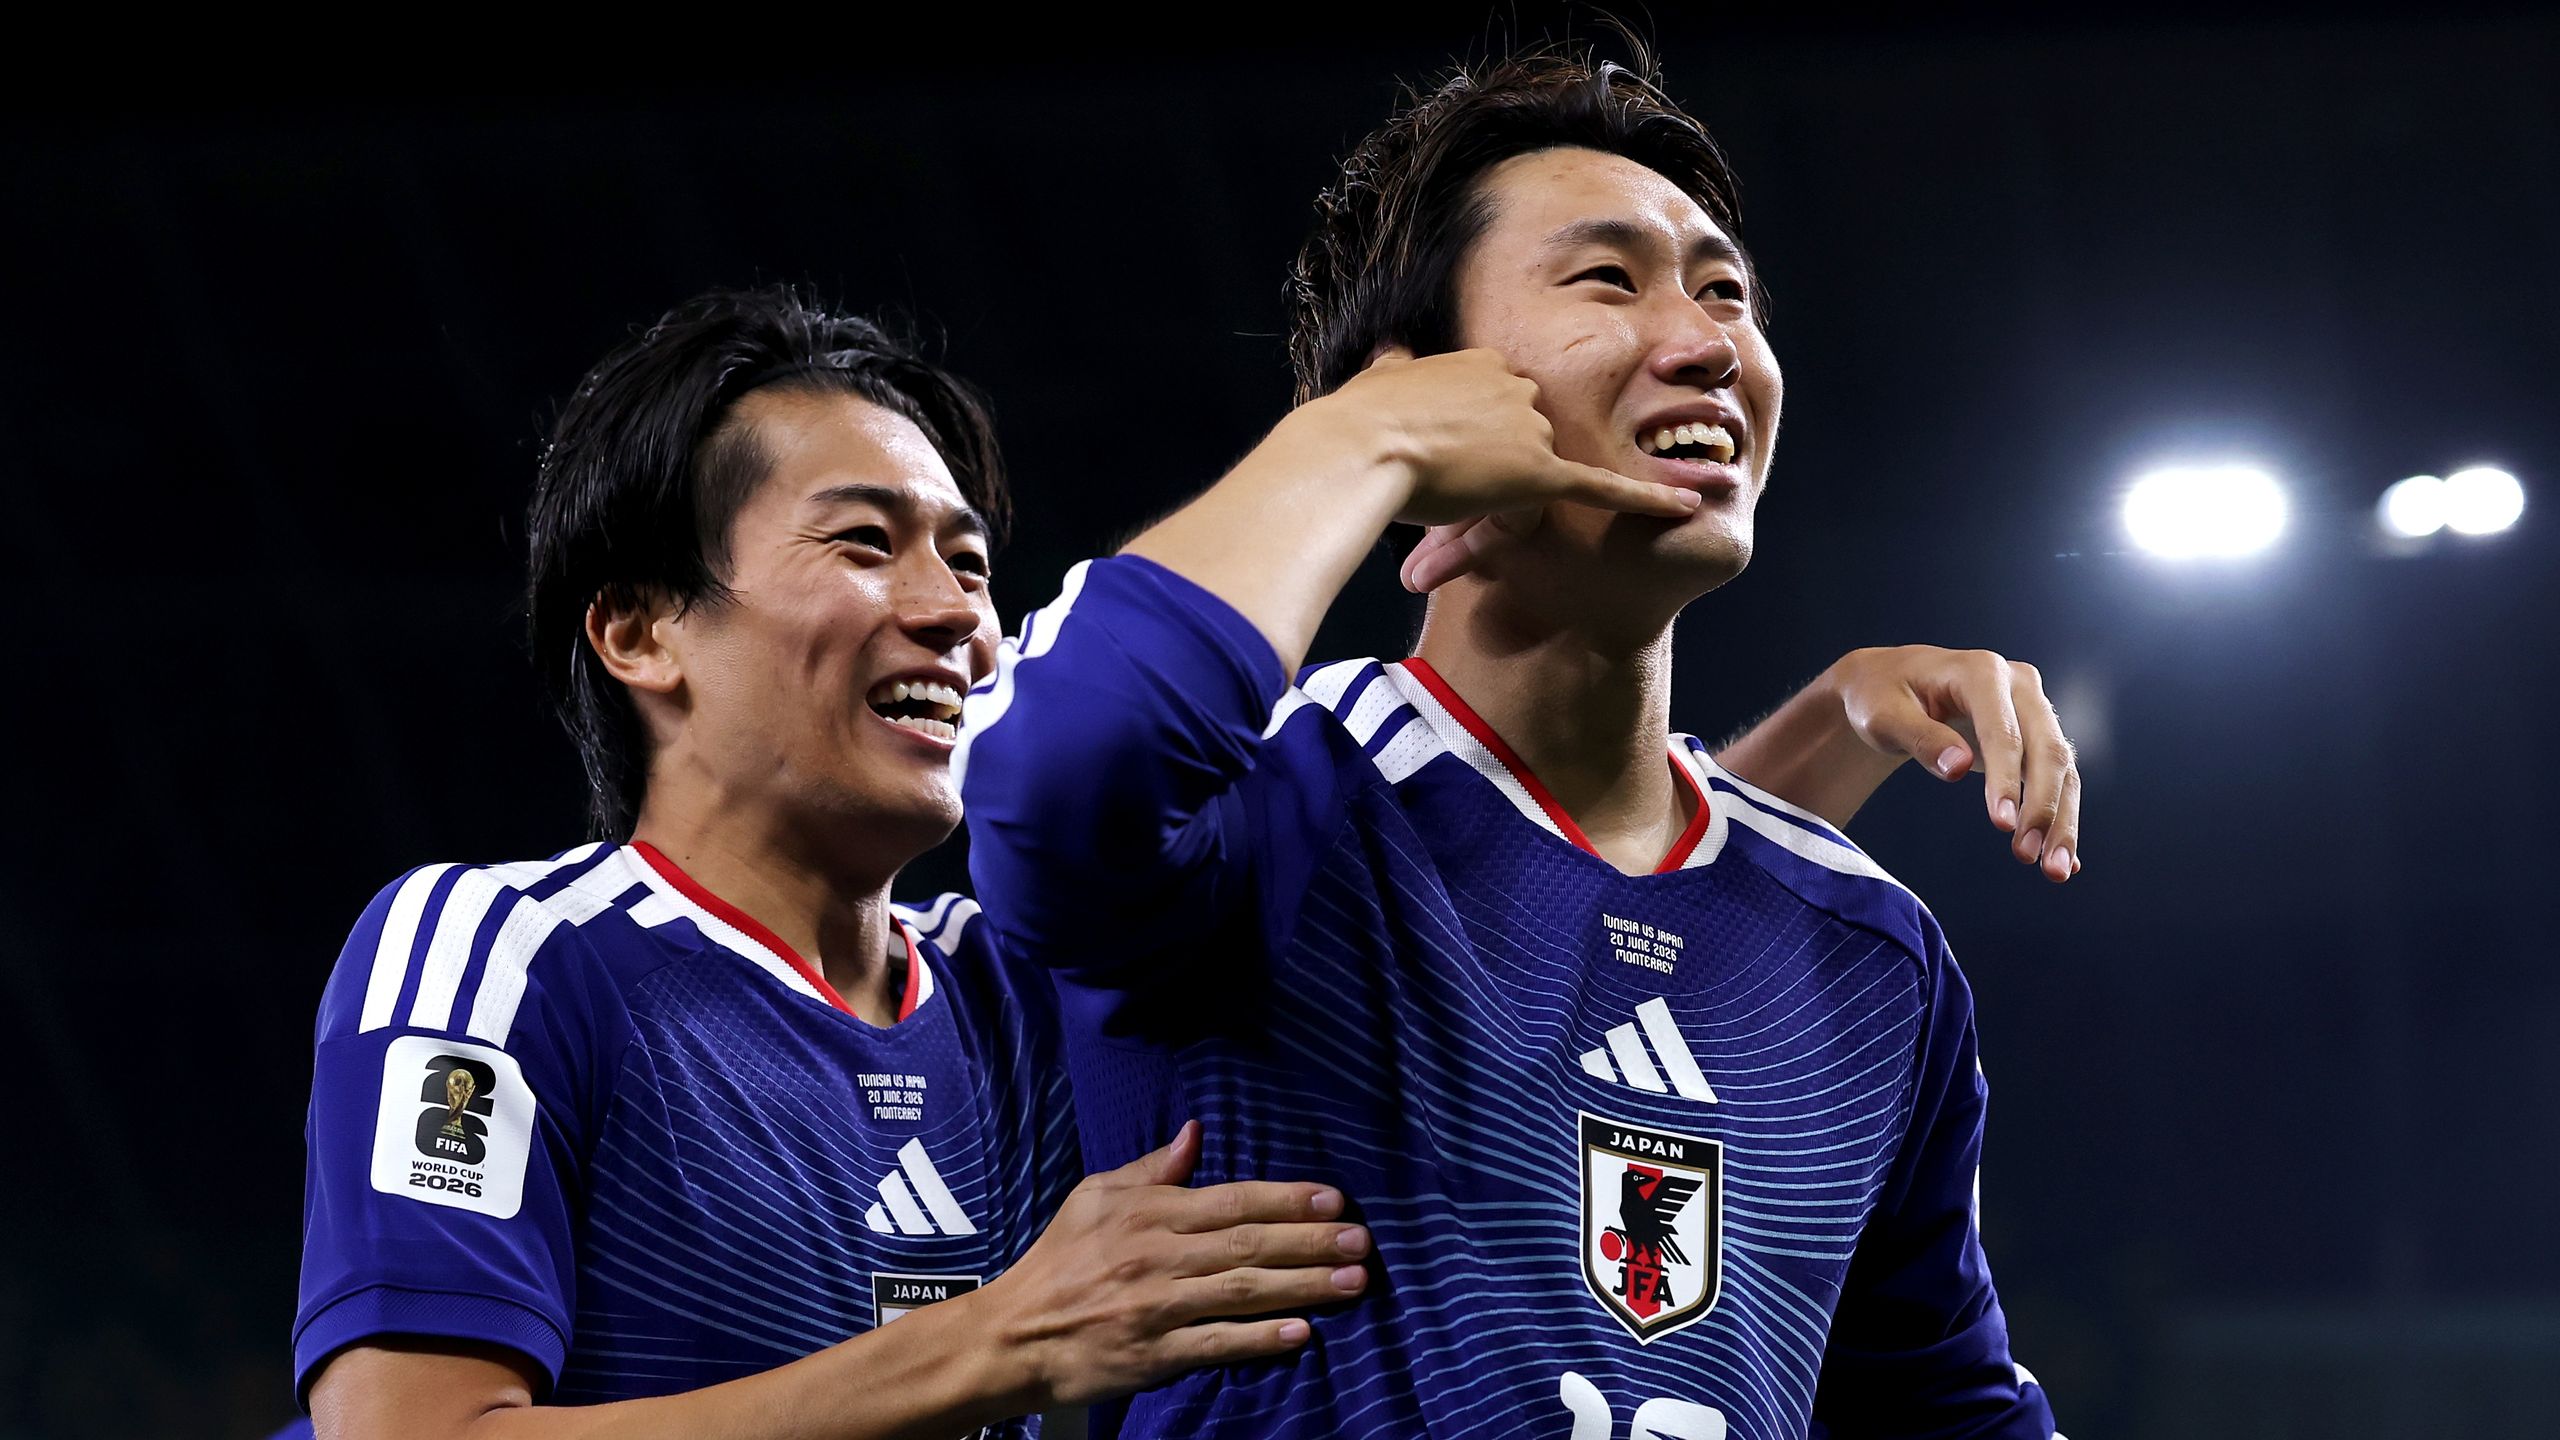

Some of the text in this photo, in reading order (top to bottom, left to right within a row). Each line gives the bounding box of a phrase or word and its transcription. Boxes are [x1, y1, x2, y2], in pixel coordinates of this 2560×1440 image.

[1602, 913, 1640, 935] TUNISIA
[1656, 929, 1684, 949] JAPAN
[1610, 932, 1677, 962] 20 JUNE 2026
[1615, 948, 1674, 975] MONTERREY
[856, 1073, 892, 1088] TUNISIA
[904, 1074, 927, 1089] JAPAN
[867, 1090, 924, 1105] 20 JUNE 2026
[873, 1106, 922, 1121] MONTERREY
[435, 1136, 468, 1156] FIFA
[1609, 1131, 1684, 1160] JAPAN
[411, 1160, 484, 1182] WORLD CUP
[408, 1172, 483, 1198] 2026
[892, 1284, 947, 1300] JAPAN
[1612, 1266, 1676, 1308] JFA
